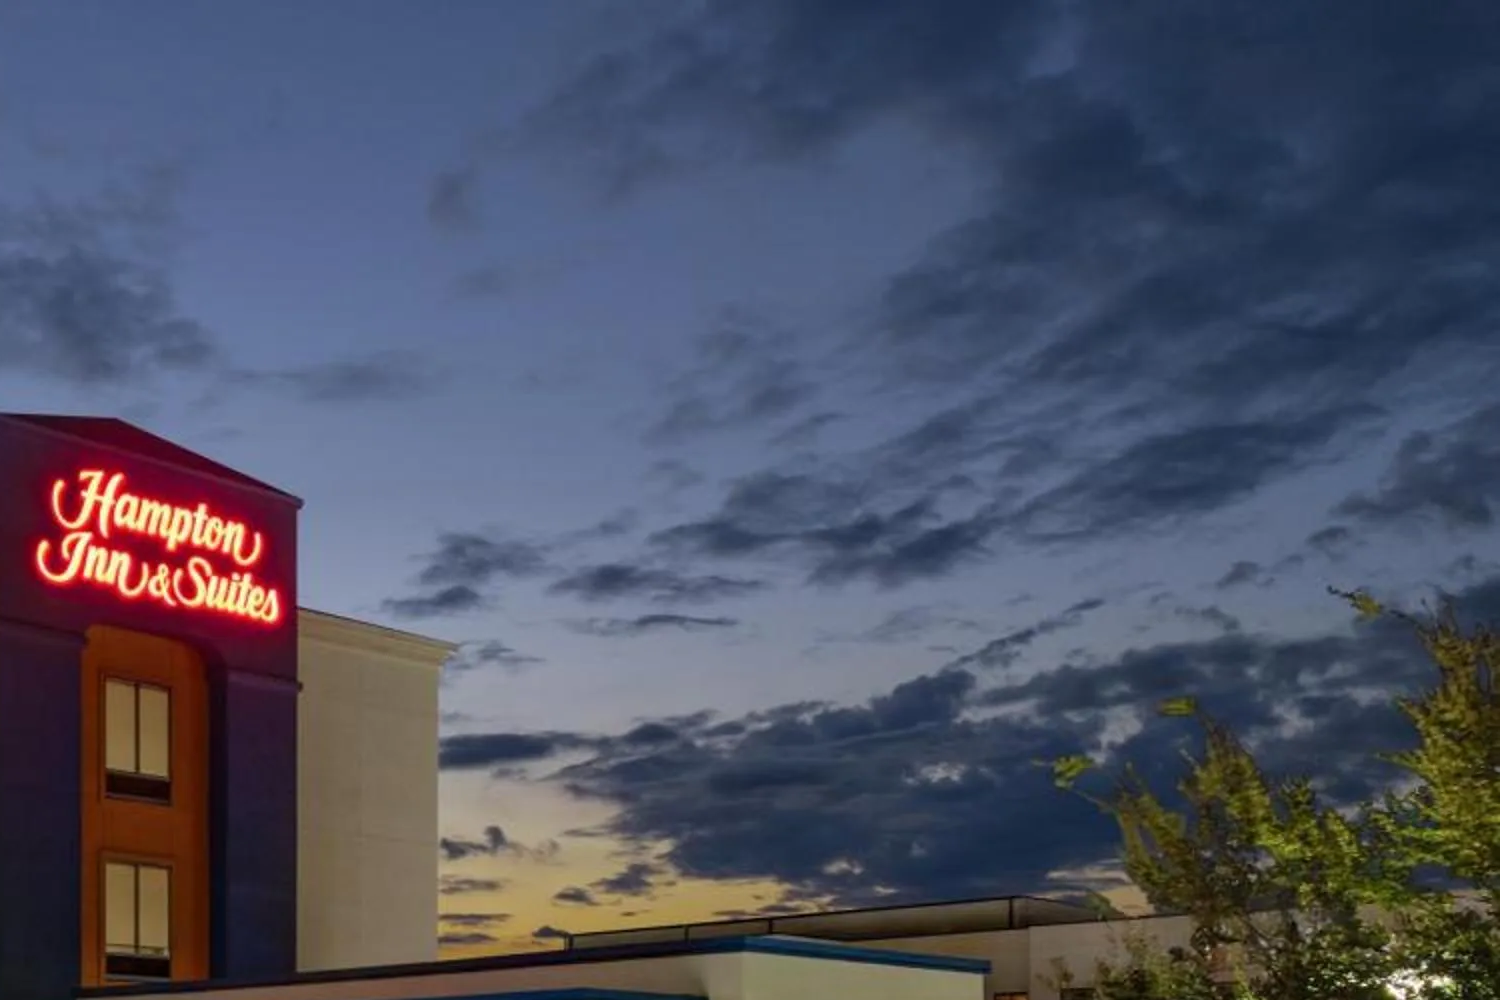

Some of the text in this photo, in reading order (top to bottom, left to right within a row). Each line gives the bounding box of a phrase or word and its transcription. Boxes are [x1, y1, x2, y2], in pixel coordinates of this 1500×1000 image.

[52, 469, 262, 566] Hampton
[36, 531, 281, 624] Inn & Suites
